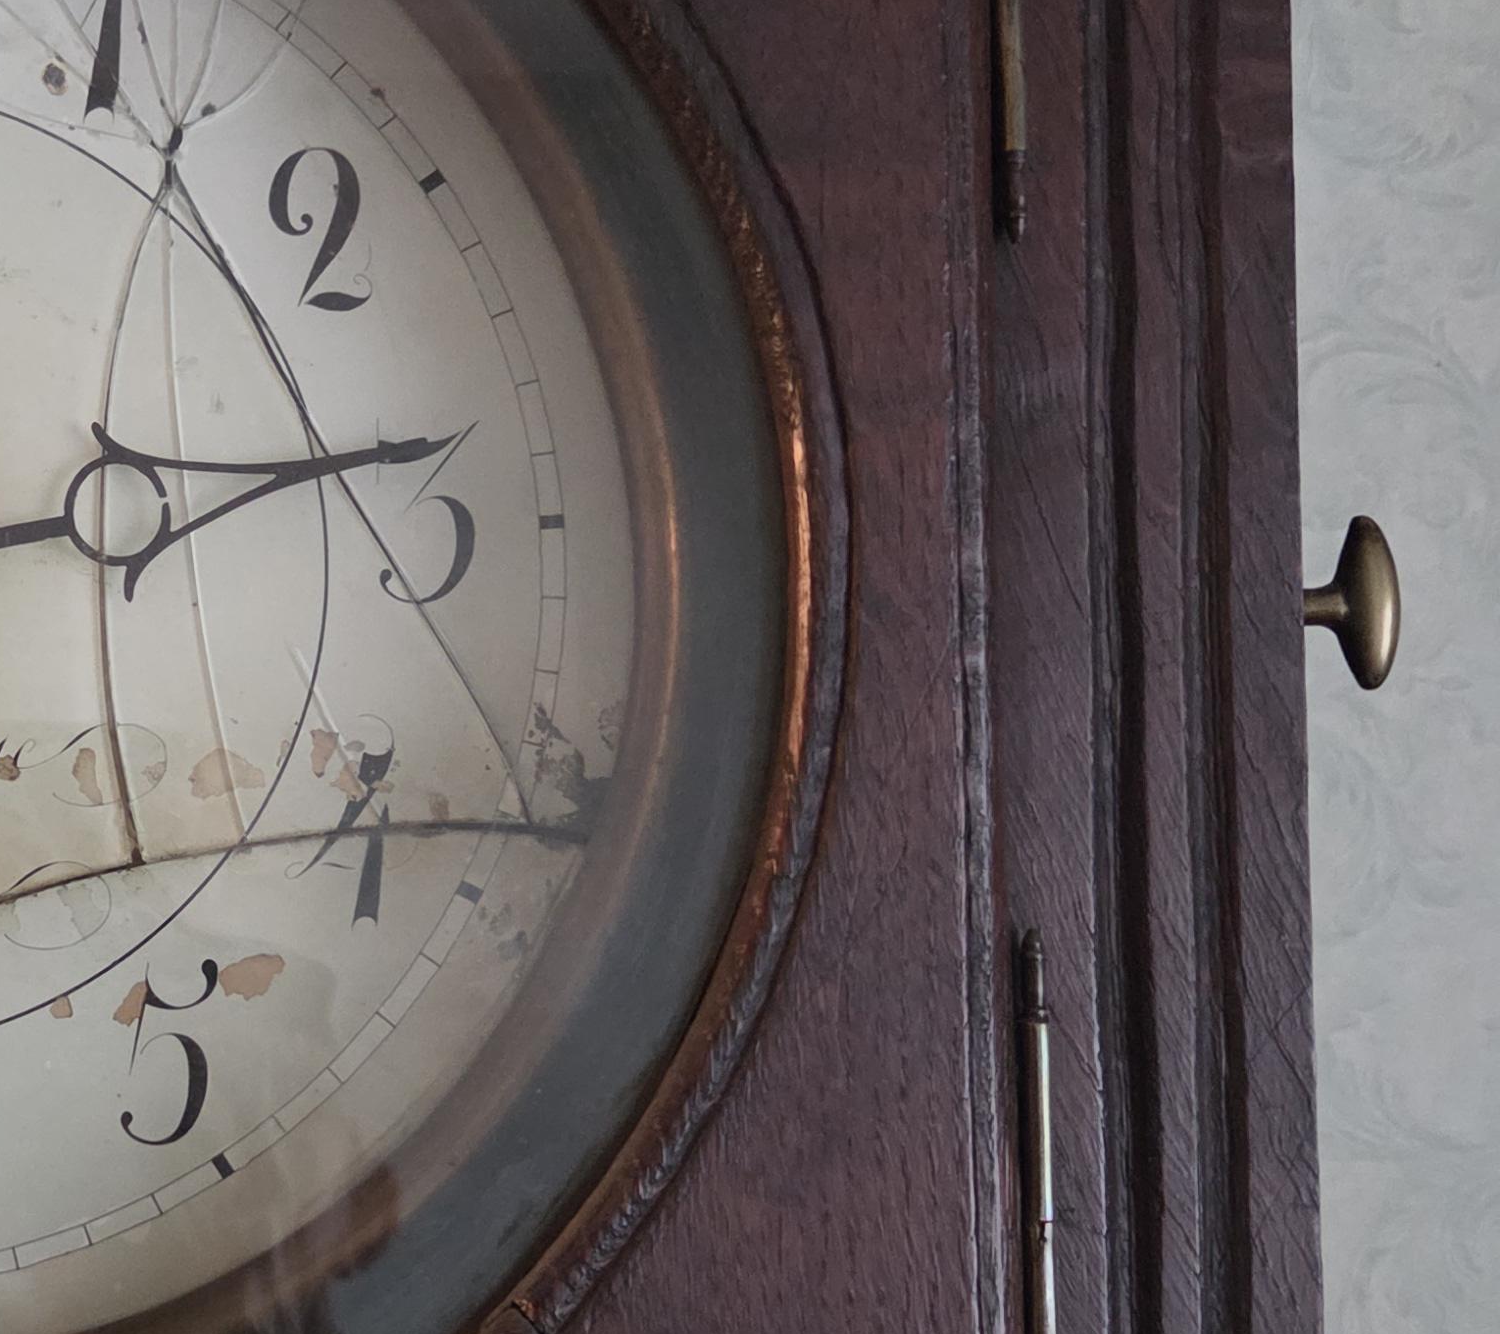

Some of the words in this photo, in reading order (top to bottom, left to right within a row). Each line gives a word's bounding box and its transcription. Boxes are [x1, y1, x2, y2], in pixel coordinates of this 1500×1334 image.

[268, 146, 374, 312] 2
[375, 418, 480, 605] 3
[284, 717, 396, 931] 4
[120, 958, 219, 1146] 5
